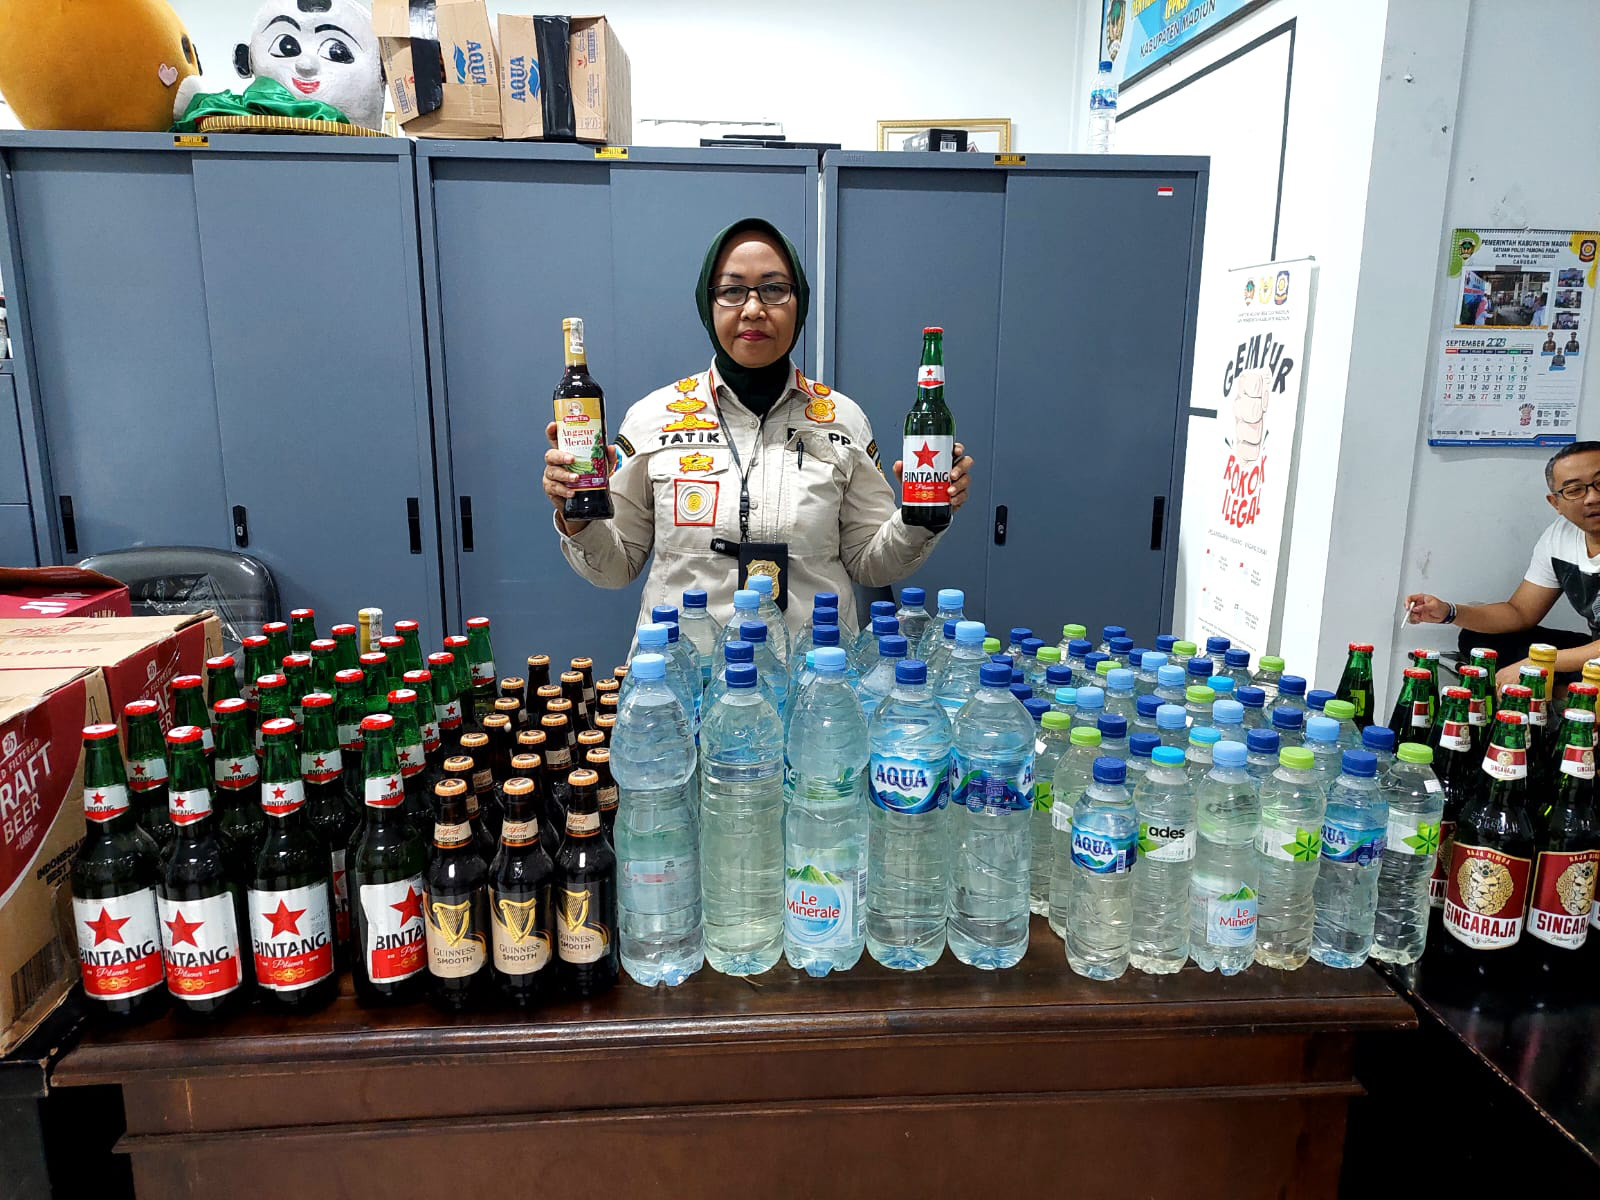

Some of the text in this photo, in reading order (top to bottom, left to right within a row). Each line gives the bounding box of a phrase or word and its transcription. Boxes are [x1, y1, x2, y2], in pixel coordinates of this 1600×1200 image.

[1140, 22, 1180, 57] KABUPATEN
[1181, 0, 1216, 32] MADIUN
[466, 40, 488, 87] AQUA
[509, 55, 527, 103] AQUA
[1223, 332, 1294, 398] GEMPUR
[658, 432, 720, 446] TATIK
[904, 472, 949, 483] BINTANG
[1224, 455, 1267, 498] ROKOK
[1222, 488, 1262, 528] ILEGAL
[8, 738, 40, 773] FILTERED
[0, 740, 52, 821] RAFT
[876, 764, 929, 791] AQUA
[2, 793, 41, 845] BEER
[1149, 826, 1186, 840] ades
[1321, 825, 1347, 846] QUA
[1074, 834, 1114, 856] AQUA
[786, 897, 840, 919] Minerale
[801, 890, 817, 906] Le
[1237, 908, 1249, 918] Le
[1445, 904, 1516, 938] SINGARAJA
[1537, 911, 1588, 934] SINGAR
[254, 932, 327, 959] BINTANG
[376, 926, 424, 950] BINTA
[500, 943, 540, 954] GUINNESS
[558, 934, 595, 943] GUINNESS
[164, 945, 229, 968] INTANG
[434, 947, 476, 956] GUINNESS
[437, 956, 473, 964] SMOOTH
[502, 953, 537, 962] SMOOTH
